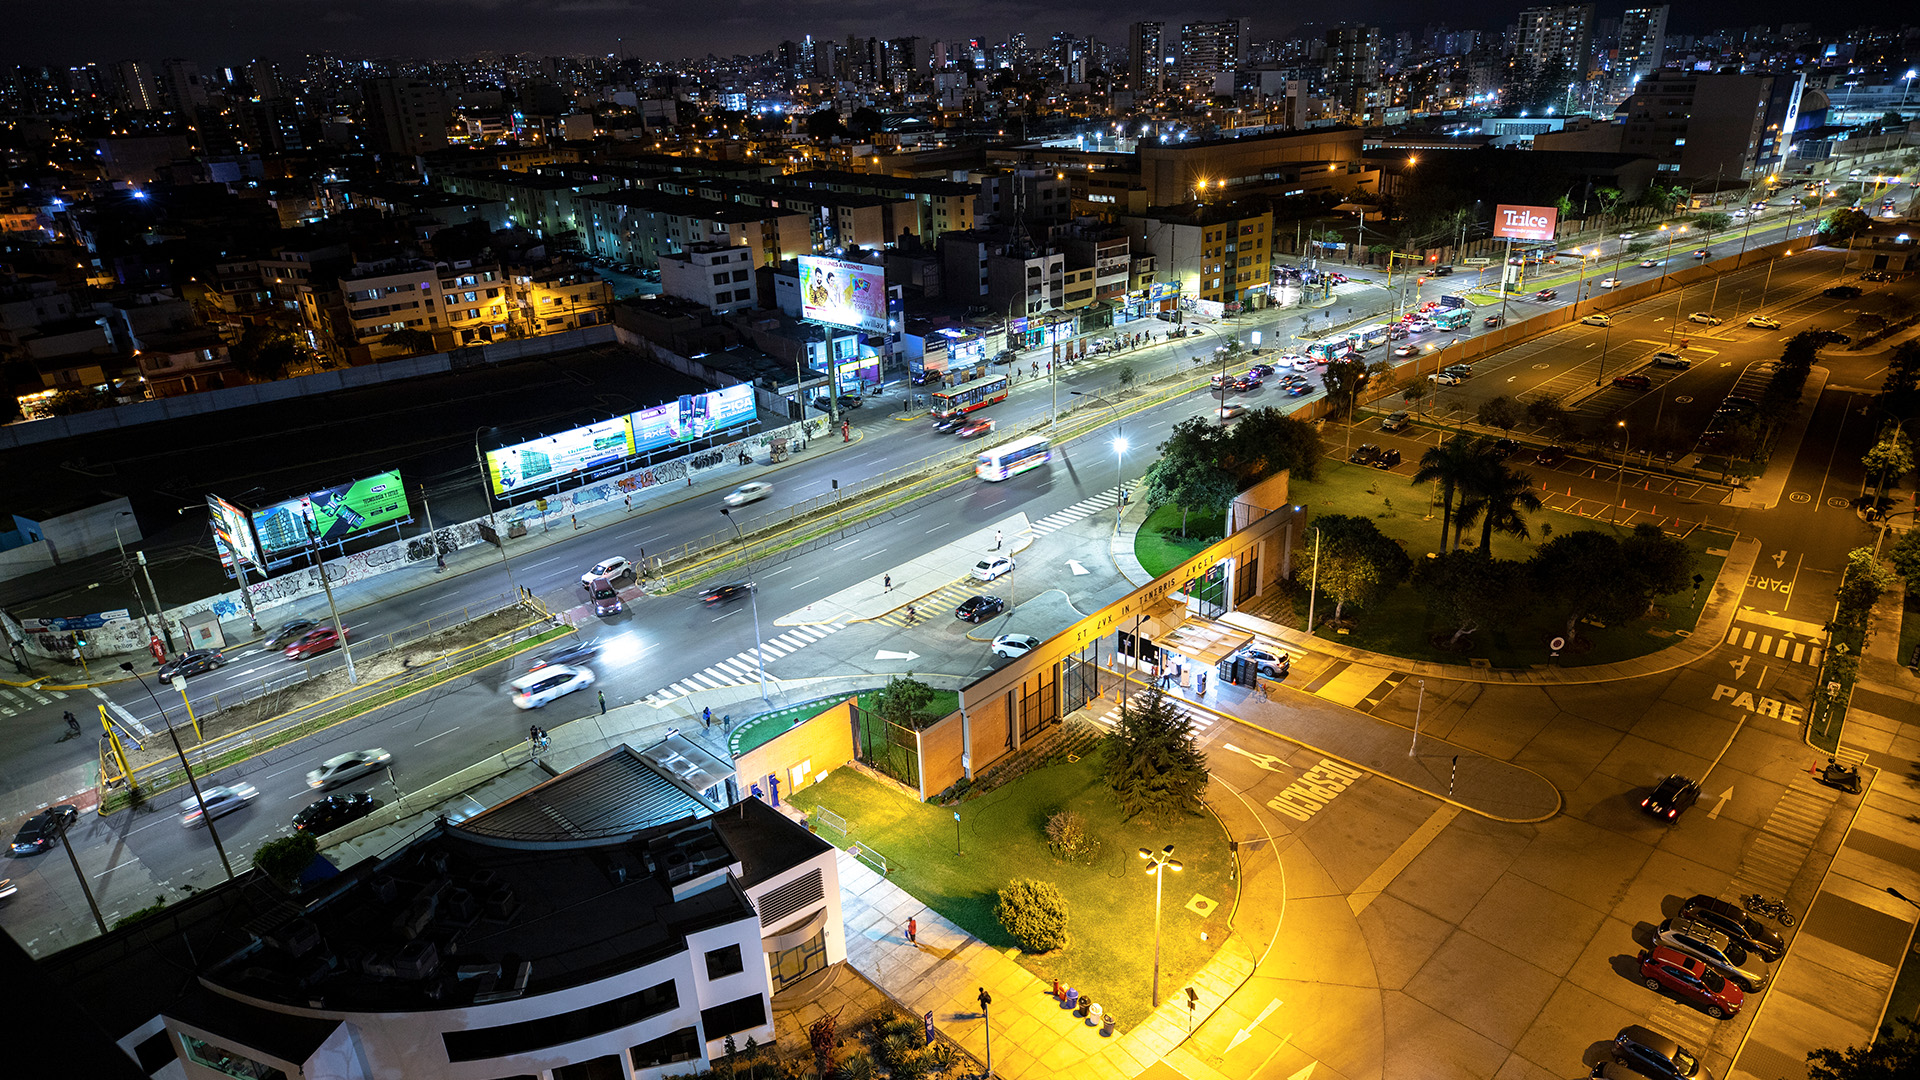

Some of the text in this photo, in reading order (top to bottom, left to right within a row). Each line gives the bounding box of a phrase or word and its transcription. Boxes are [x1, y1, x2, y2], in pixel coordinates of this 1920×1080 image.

[1503, 209, 1548, 228] Trilce
[823, 260, 838, 268] LUNES
[843, 263, 863, 271] VIERNES
[644, 428, 667, 440] AXE
[1746, 574, 1792, 594] PARE
[1121, 605, 1130, 615] IN
[1711, 683, 1804, 725] PARE
[1266, 758, 1363, 822] DESPACIO
